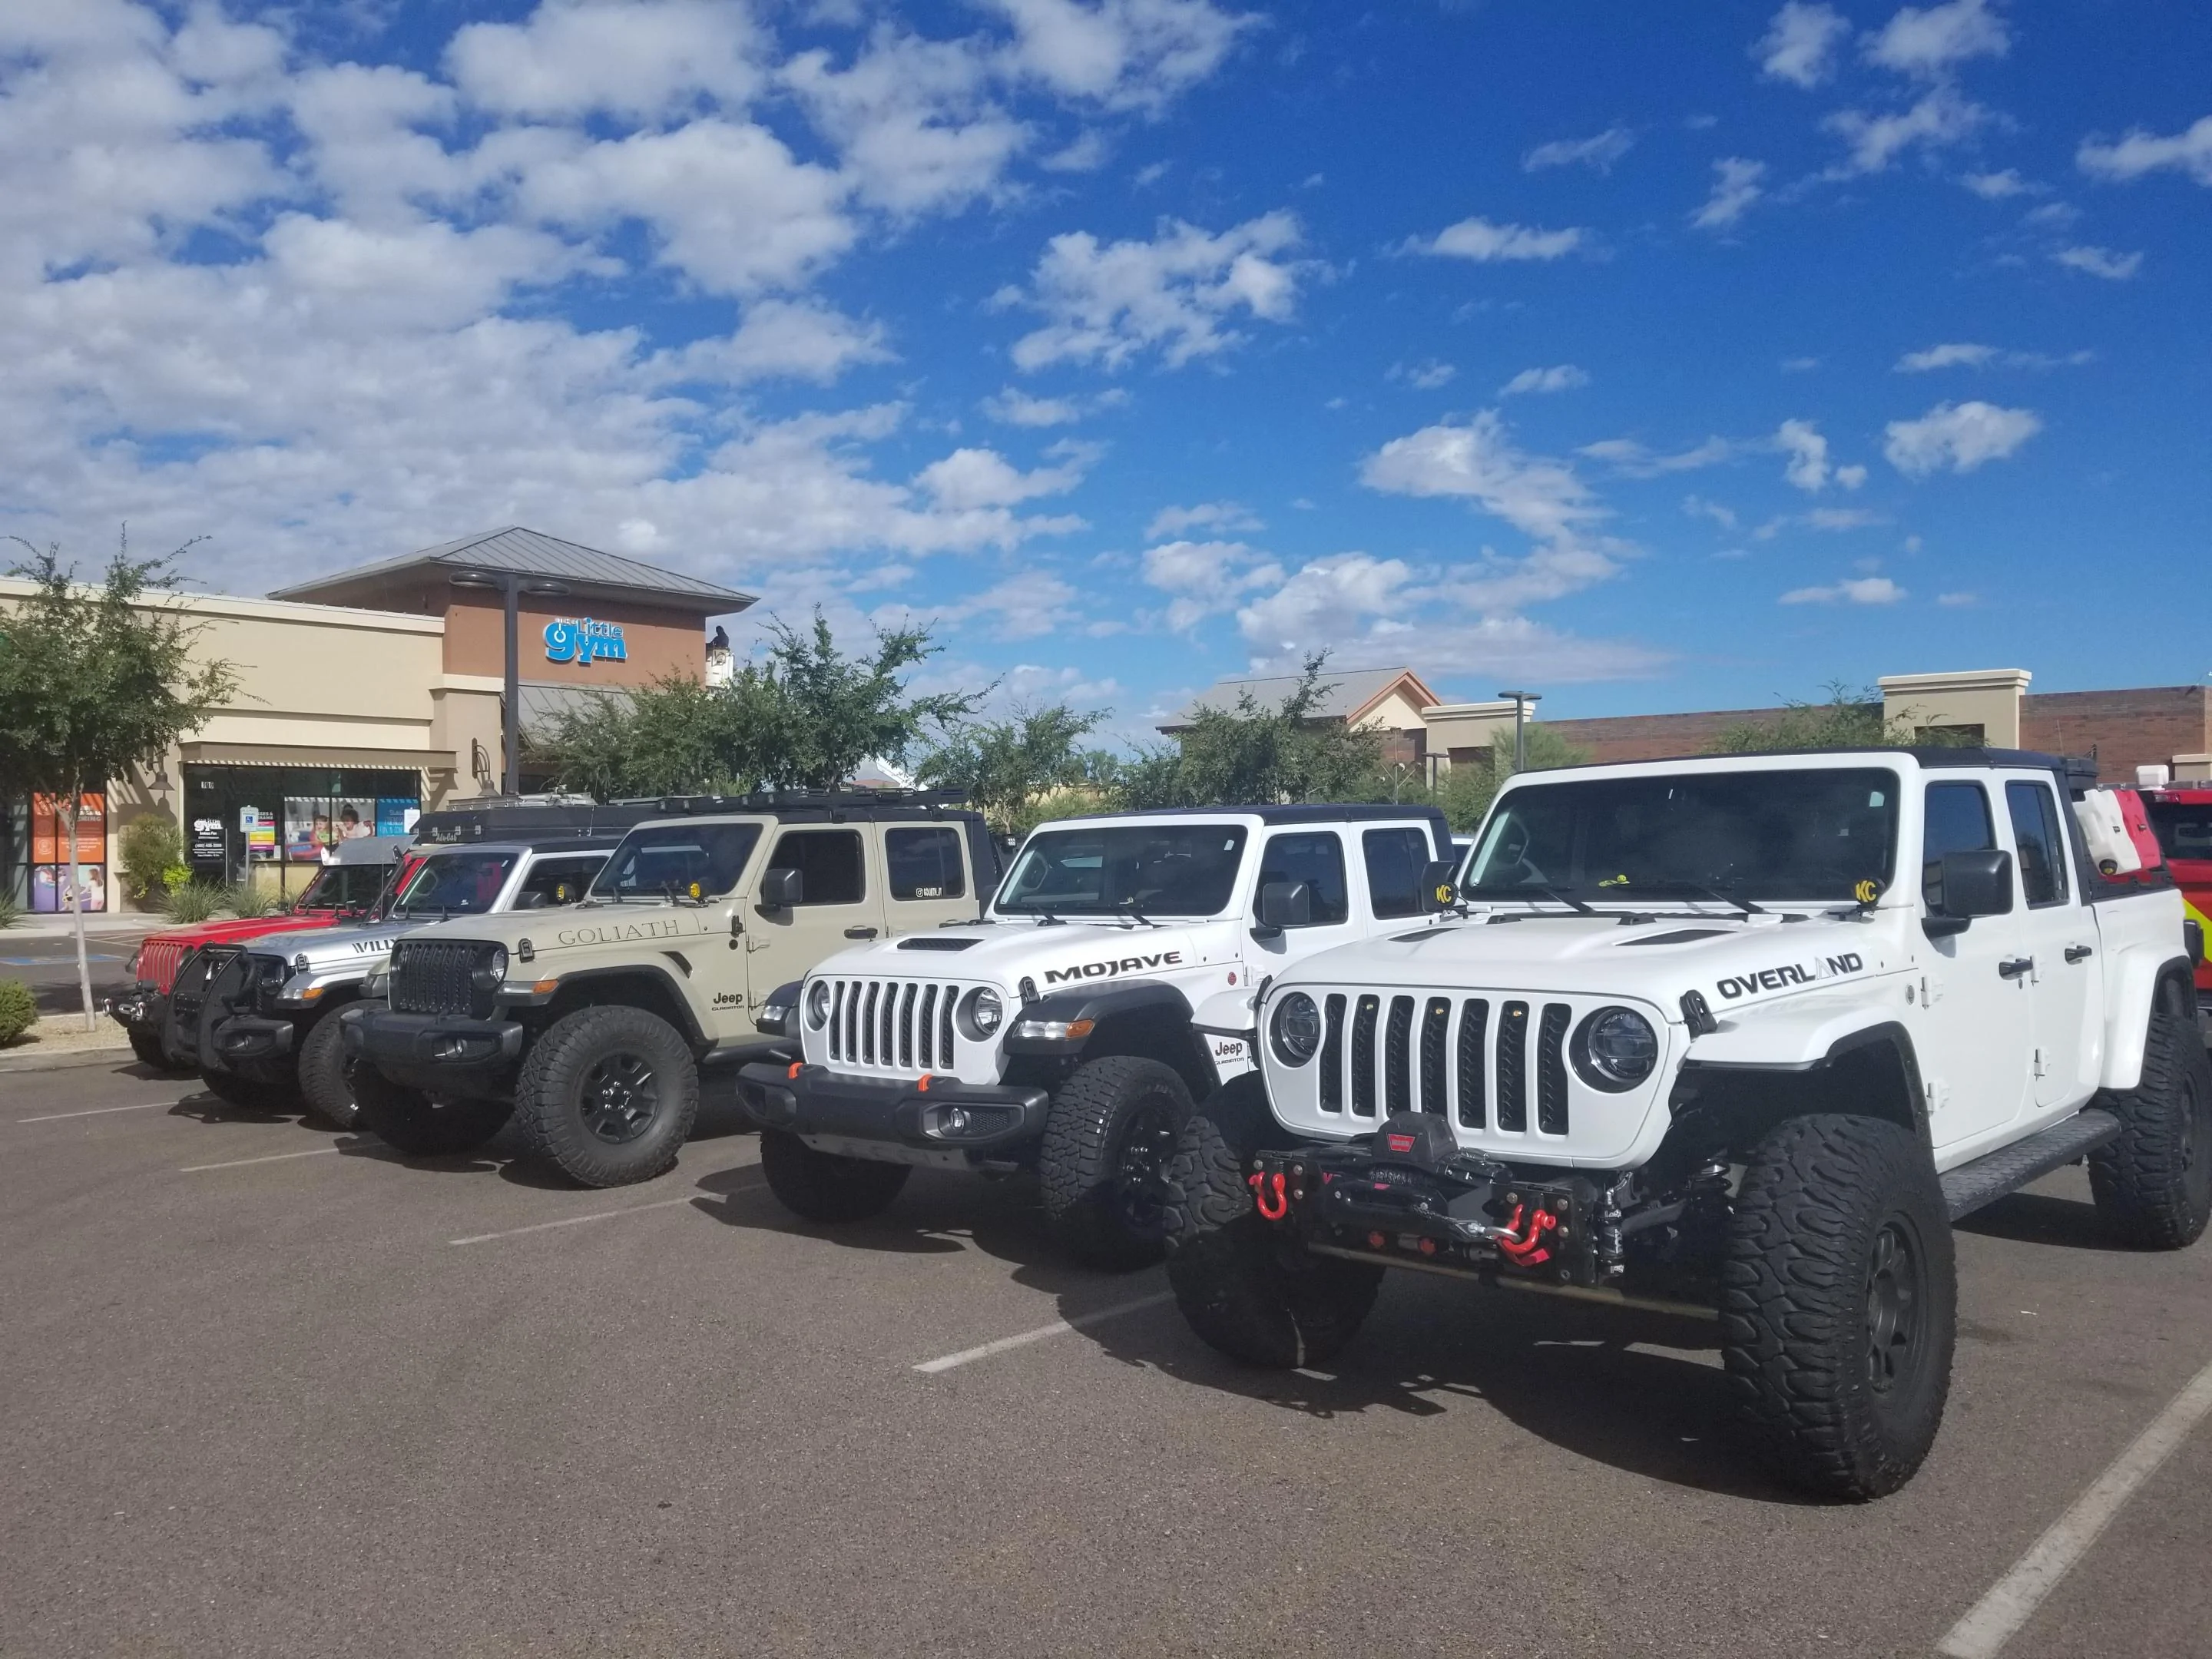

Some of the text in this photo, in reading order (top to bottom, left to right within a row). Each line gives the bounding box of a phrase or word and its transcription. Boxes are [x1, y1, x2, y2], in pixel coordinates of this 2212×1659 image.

[543, 621, 628, 664] gym
[1436, 885, 1452, 903] KC
[1856, 880, 1876, 902] KC
[558, 919, 679, 945] GOLIATH
[1044, 951, 1183, 984] MOJAVE
[1717, 952, 1863, 1000] OVERLAND
[714, 992, 743, 1005] Jeep
[1215, 1041, 1243, 1056] Jeep
